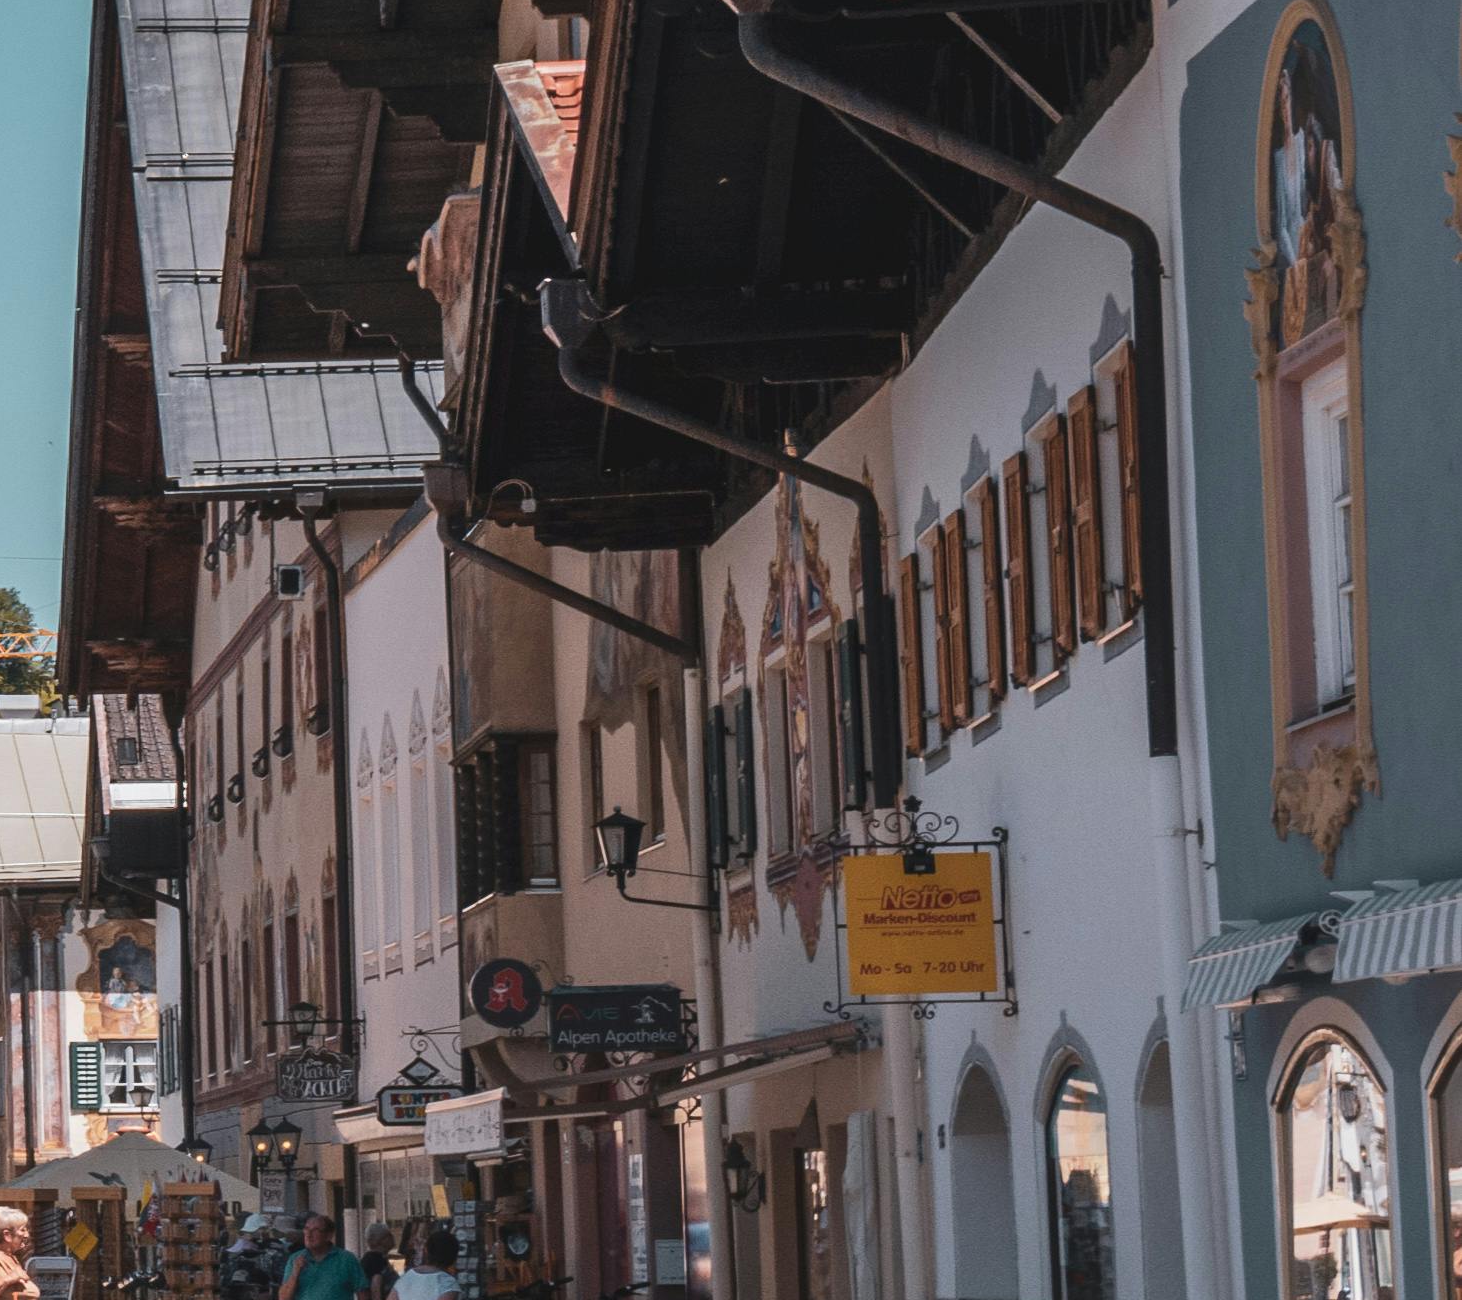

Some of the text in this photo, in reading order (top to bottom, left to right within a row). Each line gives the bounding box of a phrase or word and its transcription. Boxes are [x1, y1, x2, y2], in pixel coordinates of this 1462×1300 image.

[880, 884, 957, 911] Netto
[863, 911, 978, 925] Marken-Discount
[859, 963, 882, 976] Mo
[959, 960, 985, 974] Uhr
[557, 1027, 677, 1048] Alpen Apotheke
